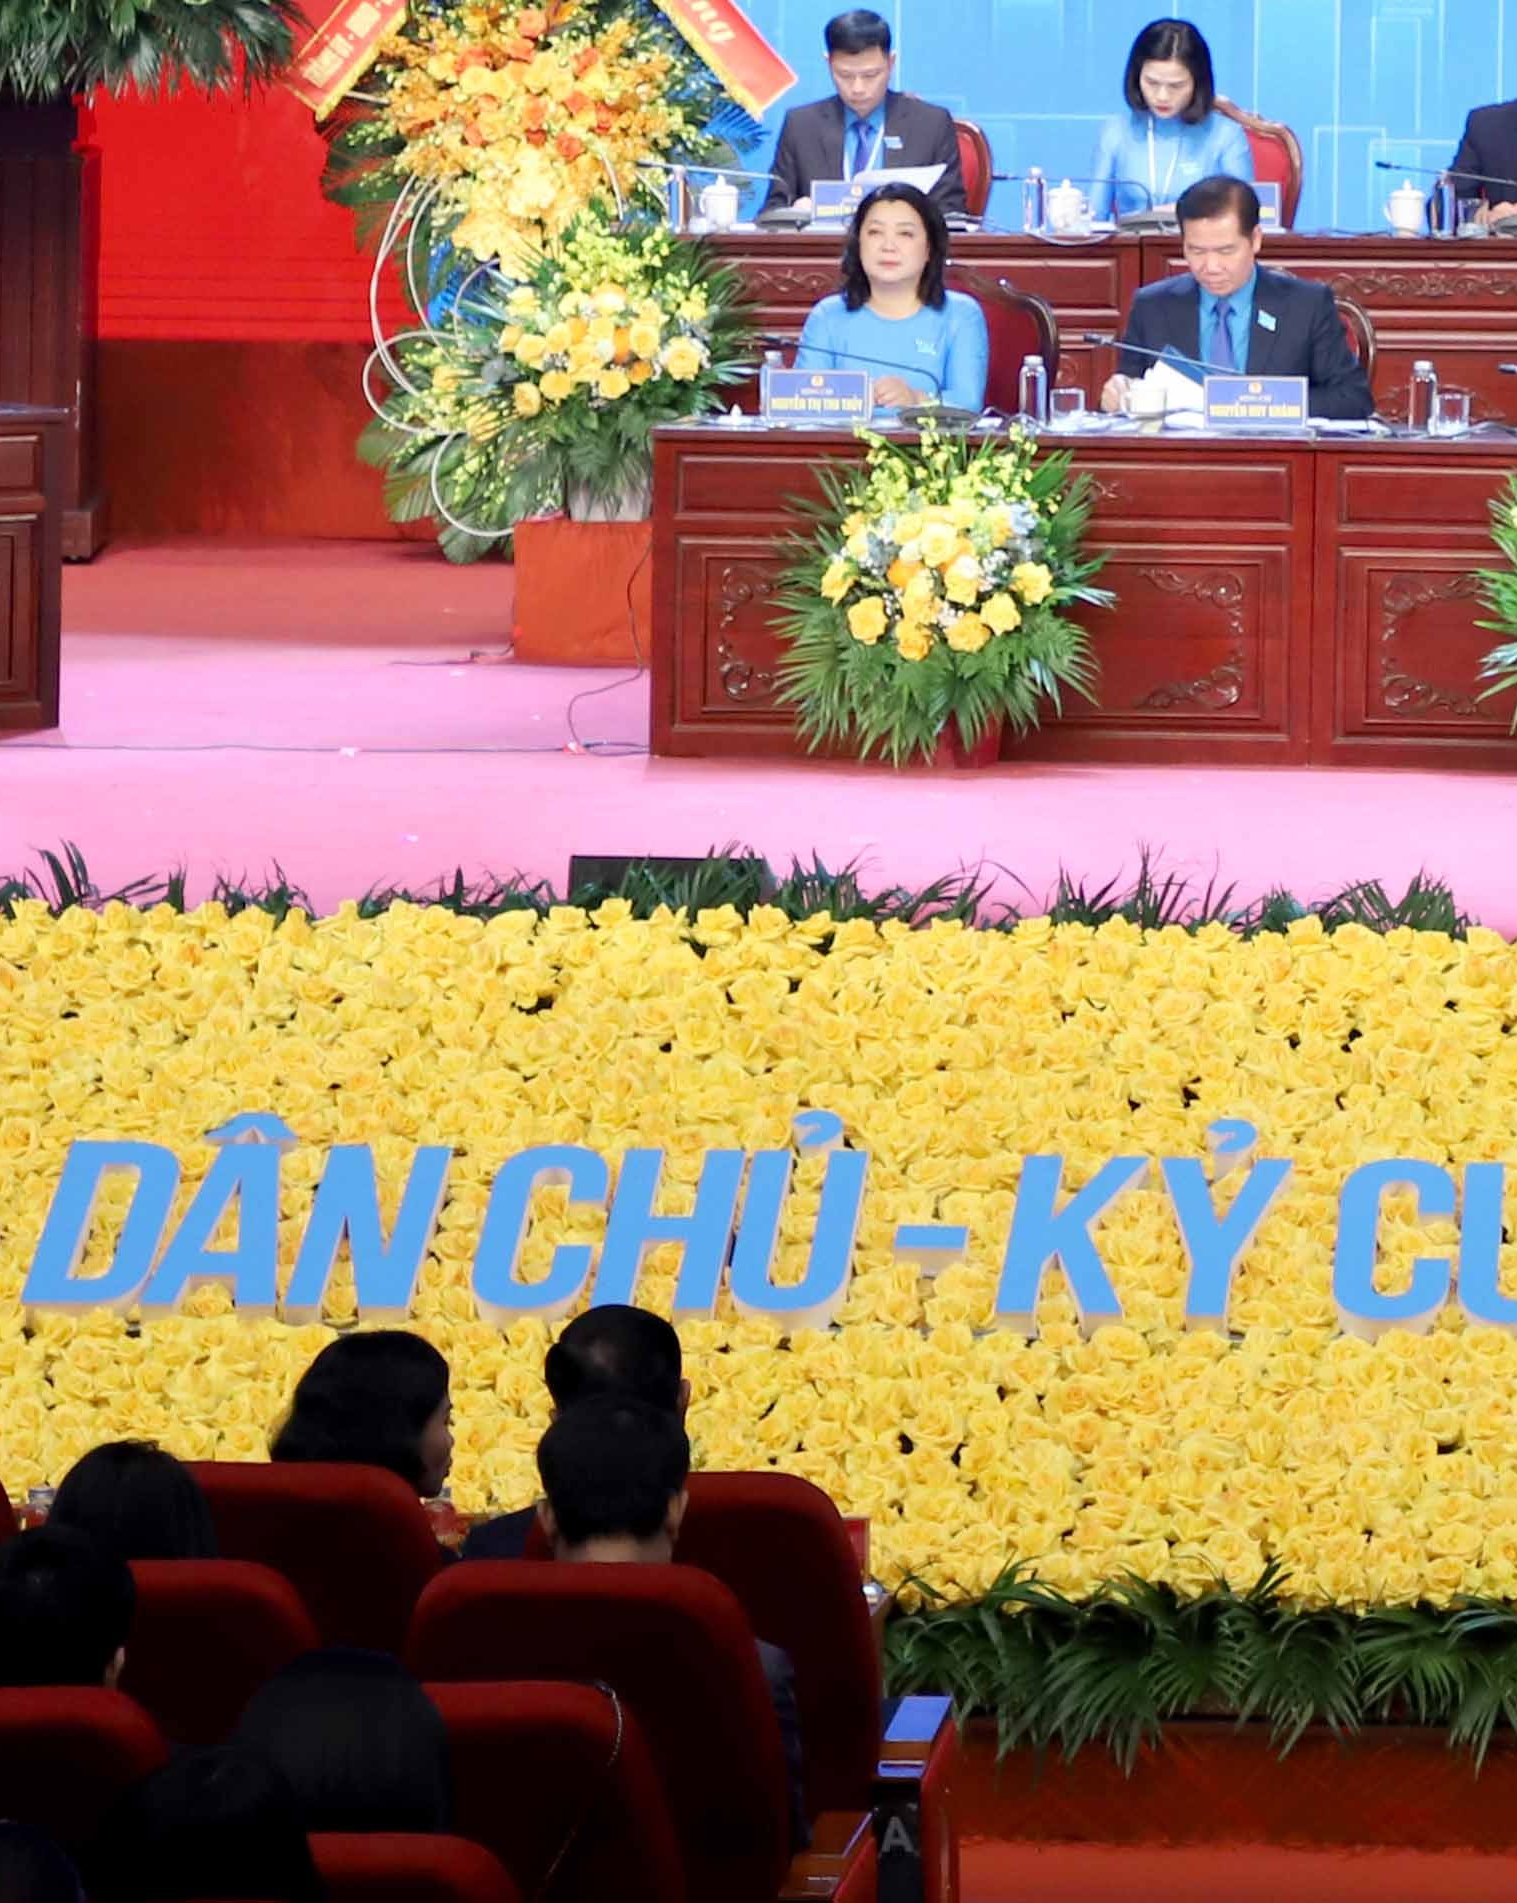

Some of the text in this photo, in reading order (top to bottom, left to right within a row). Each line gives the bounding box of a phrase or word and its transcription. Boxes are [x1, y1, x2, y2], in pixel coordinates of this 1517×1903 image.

[22, 1113, 452, 1310] DÂN
[472, 1110, 868, 1316] CHỦ
[996, 1119, 1292, 1320] KỶ
[881, 1816, 914, 1853] A
